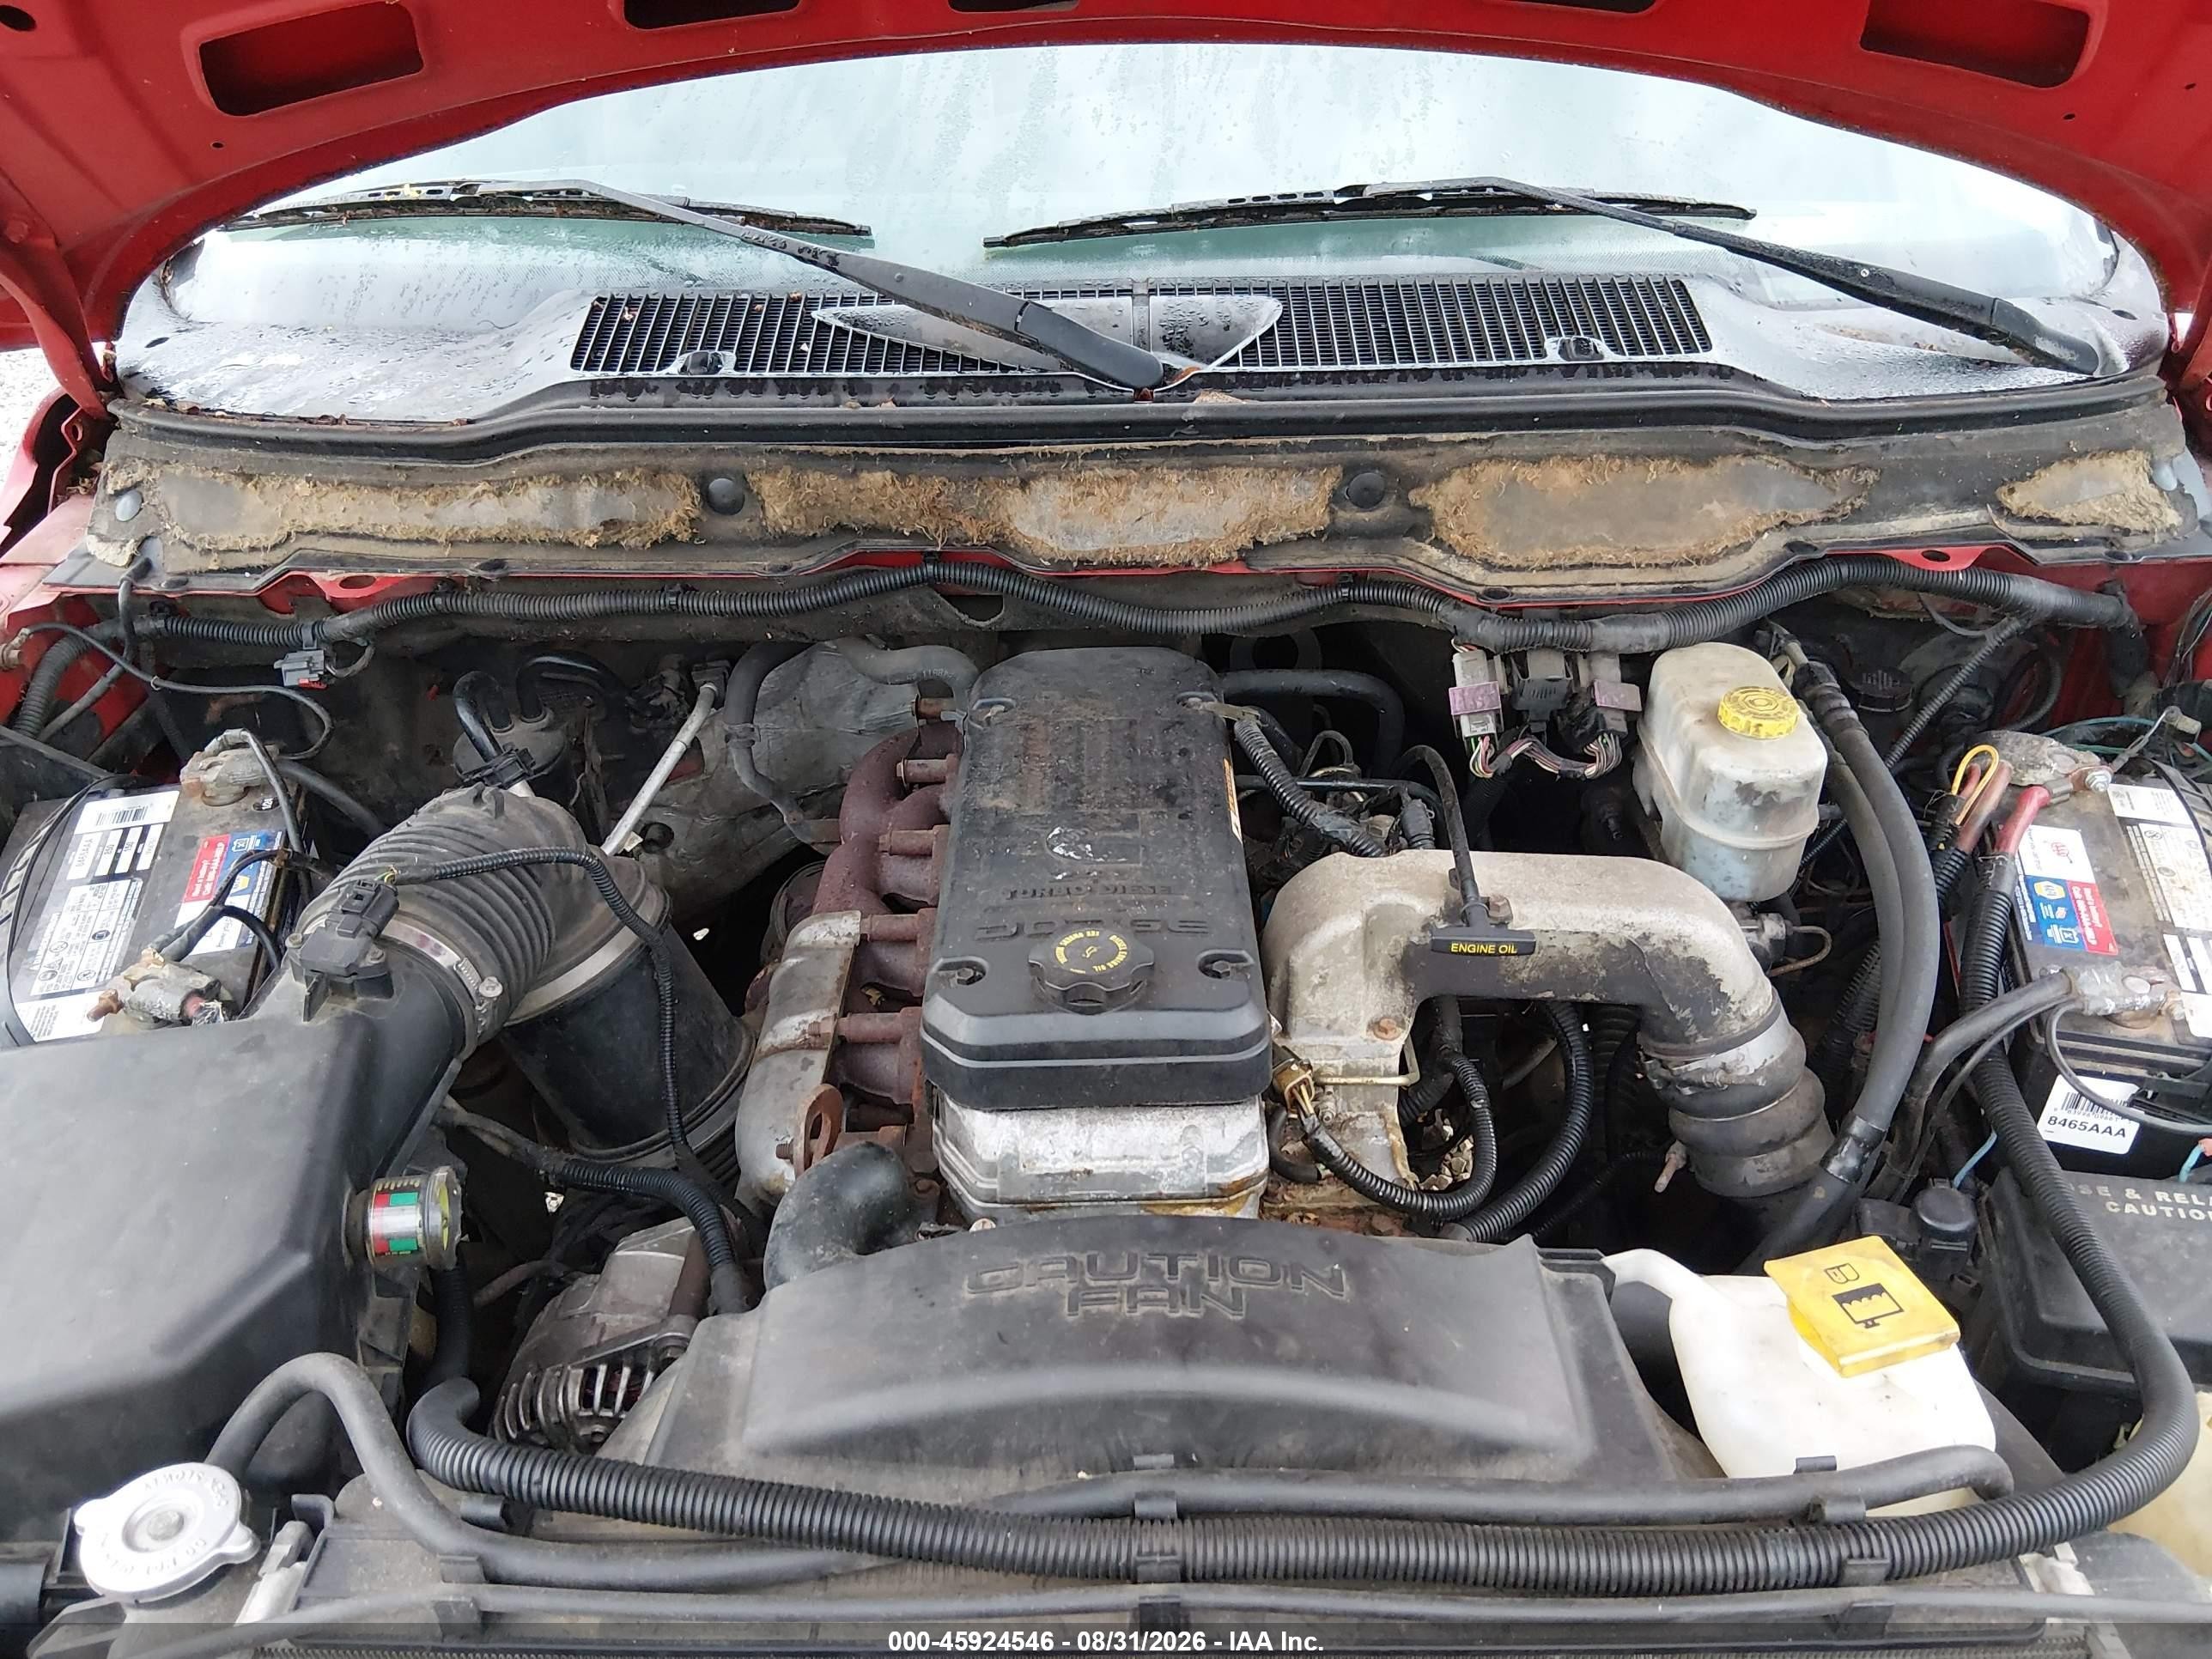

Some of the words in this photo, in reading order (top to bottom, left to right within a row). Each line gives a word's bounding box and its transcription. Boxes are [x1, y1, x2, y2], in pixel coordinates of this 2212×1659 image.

[1450, 943, 1496, 954] ENGINE
[1498, 944, 1518, 954] OIL
[2047, 1115, 2126, 1138] 8465AAA
[2124, 1188, 2142, 1200] &
[2154, 1190, 2212, 1206] REL
[965, 1252, 1346, 1298] CAUTION
[1065, 1284, 1246, 1319] FAN
